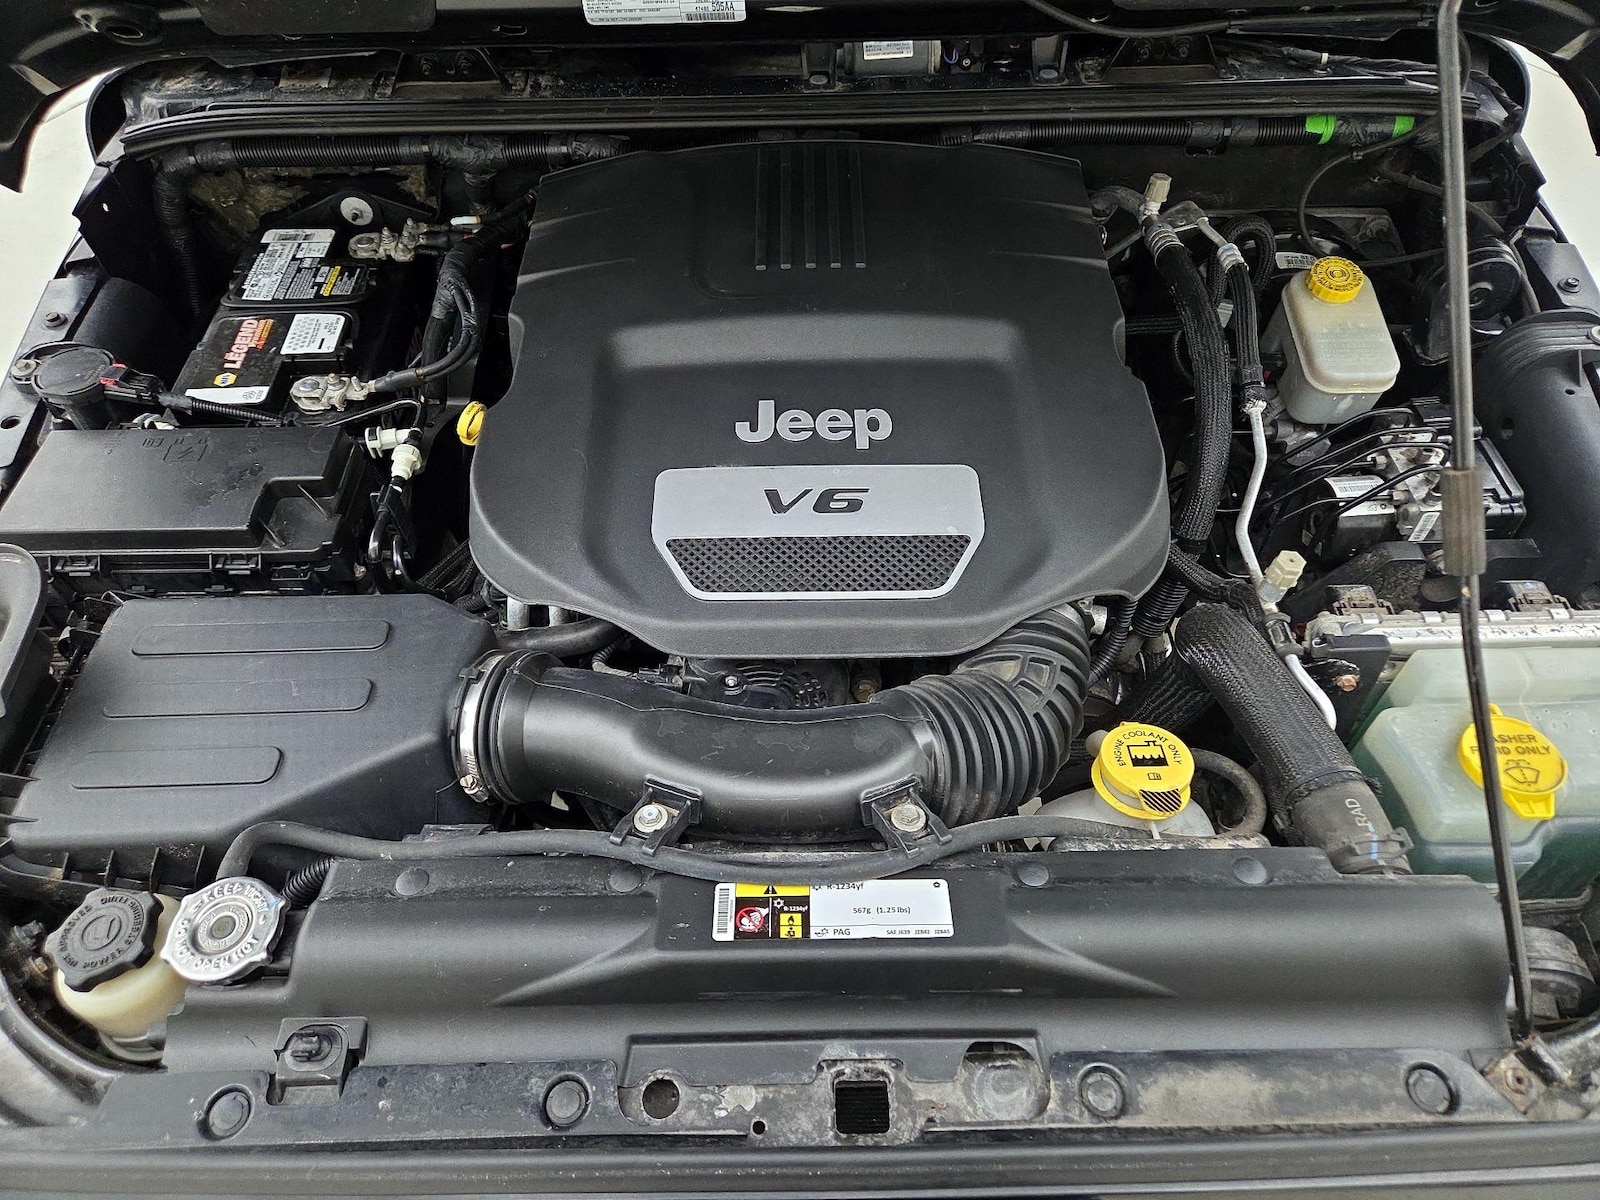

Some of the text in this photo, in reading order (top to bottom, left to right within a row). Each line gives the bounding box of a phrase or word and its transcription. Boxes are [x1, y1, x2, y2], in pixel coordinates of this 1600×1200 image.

[735, 400, 893, 450] Jeep
[763, 488, 870, 514] V6
[1113, 730, 1182, 767] ENGINE COOLANT ONLY
[1470, 745, 1551, 755] FID ONLY
[1480, 734, 1537, 743] SHER
[1345, 798, 1370, 827] RAD
[853, 907, 911, 915] 567g (1.25 lbs)
[833, 928, 851, 936] PAG
[83, 947, 124, 968] POWER
[193, 955, 231, 970] OPEN
[233, 935, 259, 961] HOT
